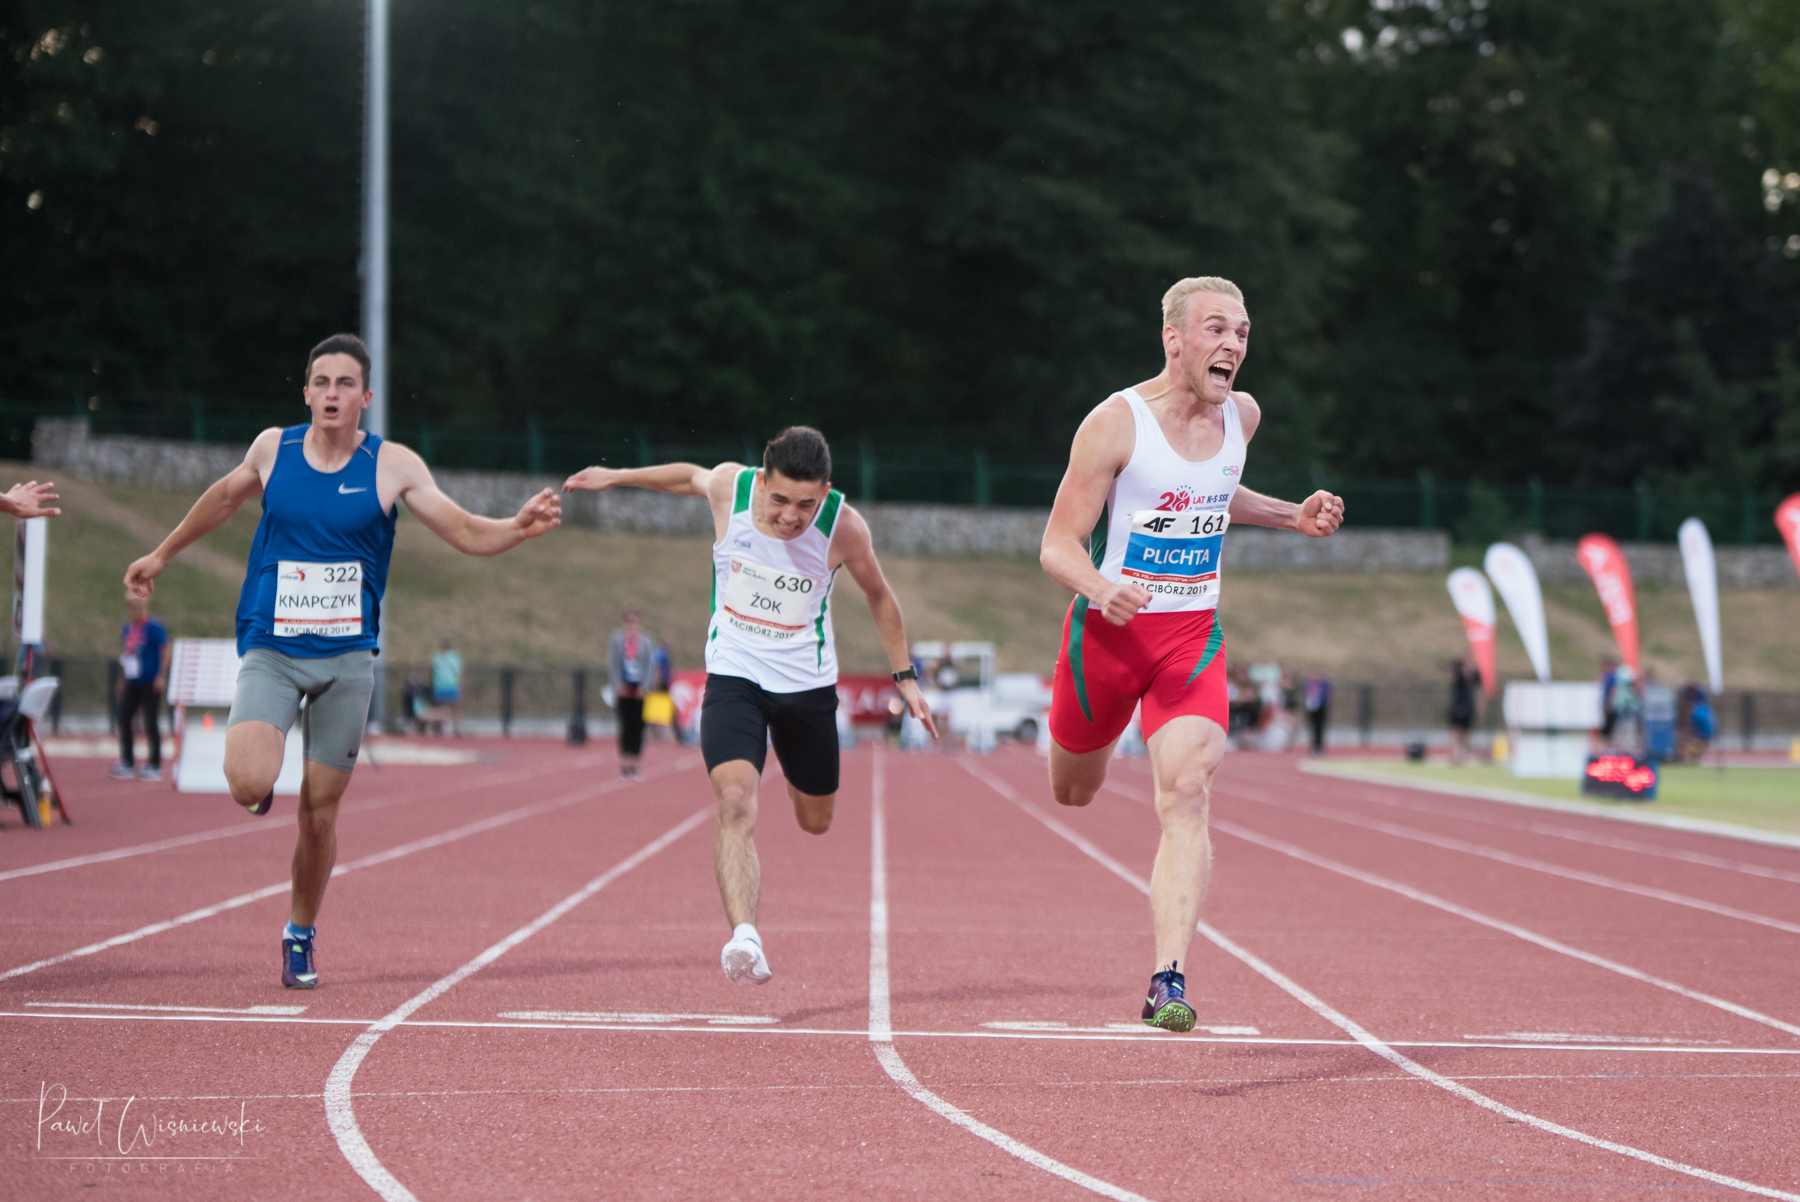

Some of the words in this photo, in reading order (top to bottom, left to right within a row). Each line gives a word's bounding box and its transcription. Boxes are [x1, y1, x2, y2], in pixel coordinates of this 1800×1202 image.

[1192, 496, 1206, 505] LAT
[1190, 514, 1224, 535] 161
[1142, 548, 1209, 565] PLICHTA
[324, 566, 357, 583] 322
[774, 575, 812, 594] 630
[1186, 584, 1208, 595] 2019
[279, 594, 356, 609] KNAPCZYK
[750, 592, 782, 614] ŻOK
[284, 624, 328, 635] RACIBÓRZ
[331, 626, 351, 635] 2019
[729, 617, 772, 637] RACIBÓRZ
